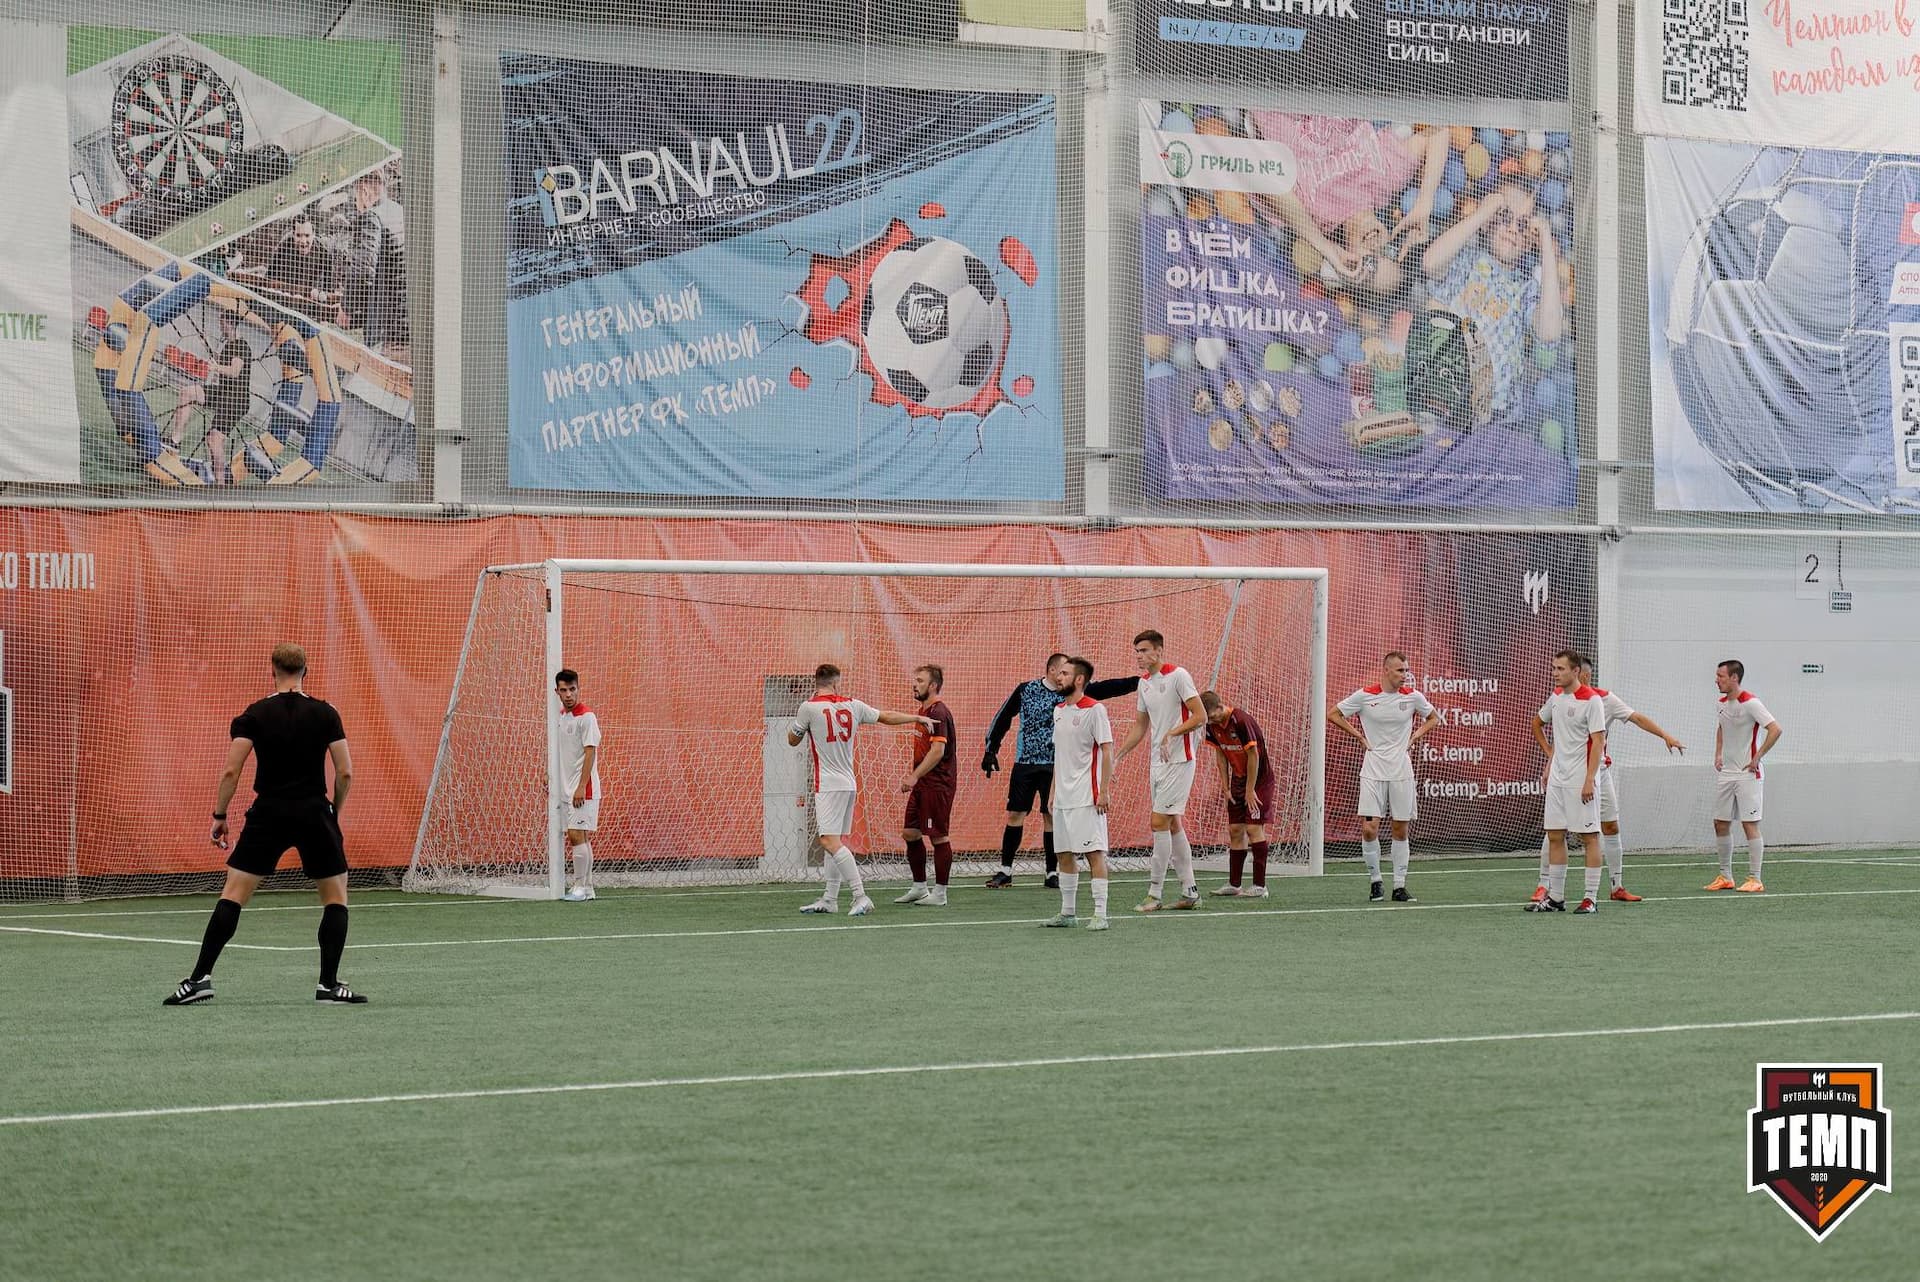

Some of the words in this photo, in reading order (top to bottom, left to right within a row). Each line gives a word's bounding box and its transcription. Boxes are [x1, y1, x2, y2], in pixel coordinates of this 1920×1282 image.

[1386, 20, 1530, 46] ВОССТАНОВИ
[1387, 44, 1455, 63] СИЛЫ.
[1772, 46, 1890, 96] каждом
[1200, 153, 1255, 174] ГРИЛЬ
[1258, 159, 1286, 177] №1
[546, 216, 636, 247] ИНТЕРНЕТ
[649, 189, 767, 229] СООБЩЕСТВО
[1165, 228, 1182, 253] В
[1188, 222, 1252, 259] ЧЁМ
[1165, 265, 1286, 303] ФИШКА,
[540, 281, 703, 350] ГЕНЕРАЛЬНЫЙ
[1166, 300, 1329, 335] БРАТИШКА?
[542, 319, 762, 404] ИНФОРМАЦИОННЫЙ
[541, 402, 645, 453] ПАРТНЕР
[650, 391, 690, 428] ФК
[695, 374, 778, 417] «ТЕМП»
[25, 551, 96, 591] ТЕМП!
[1804, 553, 1820, 583] 2
[1422, 675, 1498, 697] fctemp.ru
[822, 708, 854, 743] 19
[1452, 708, 1494, 726] Темп
[1421, 743, 1484, 766] fc.temp
